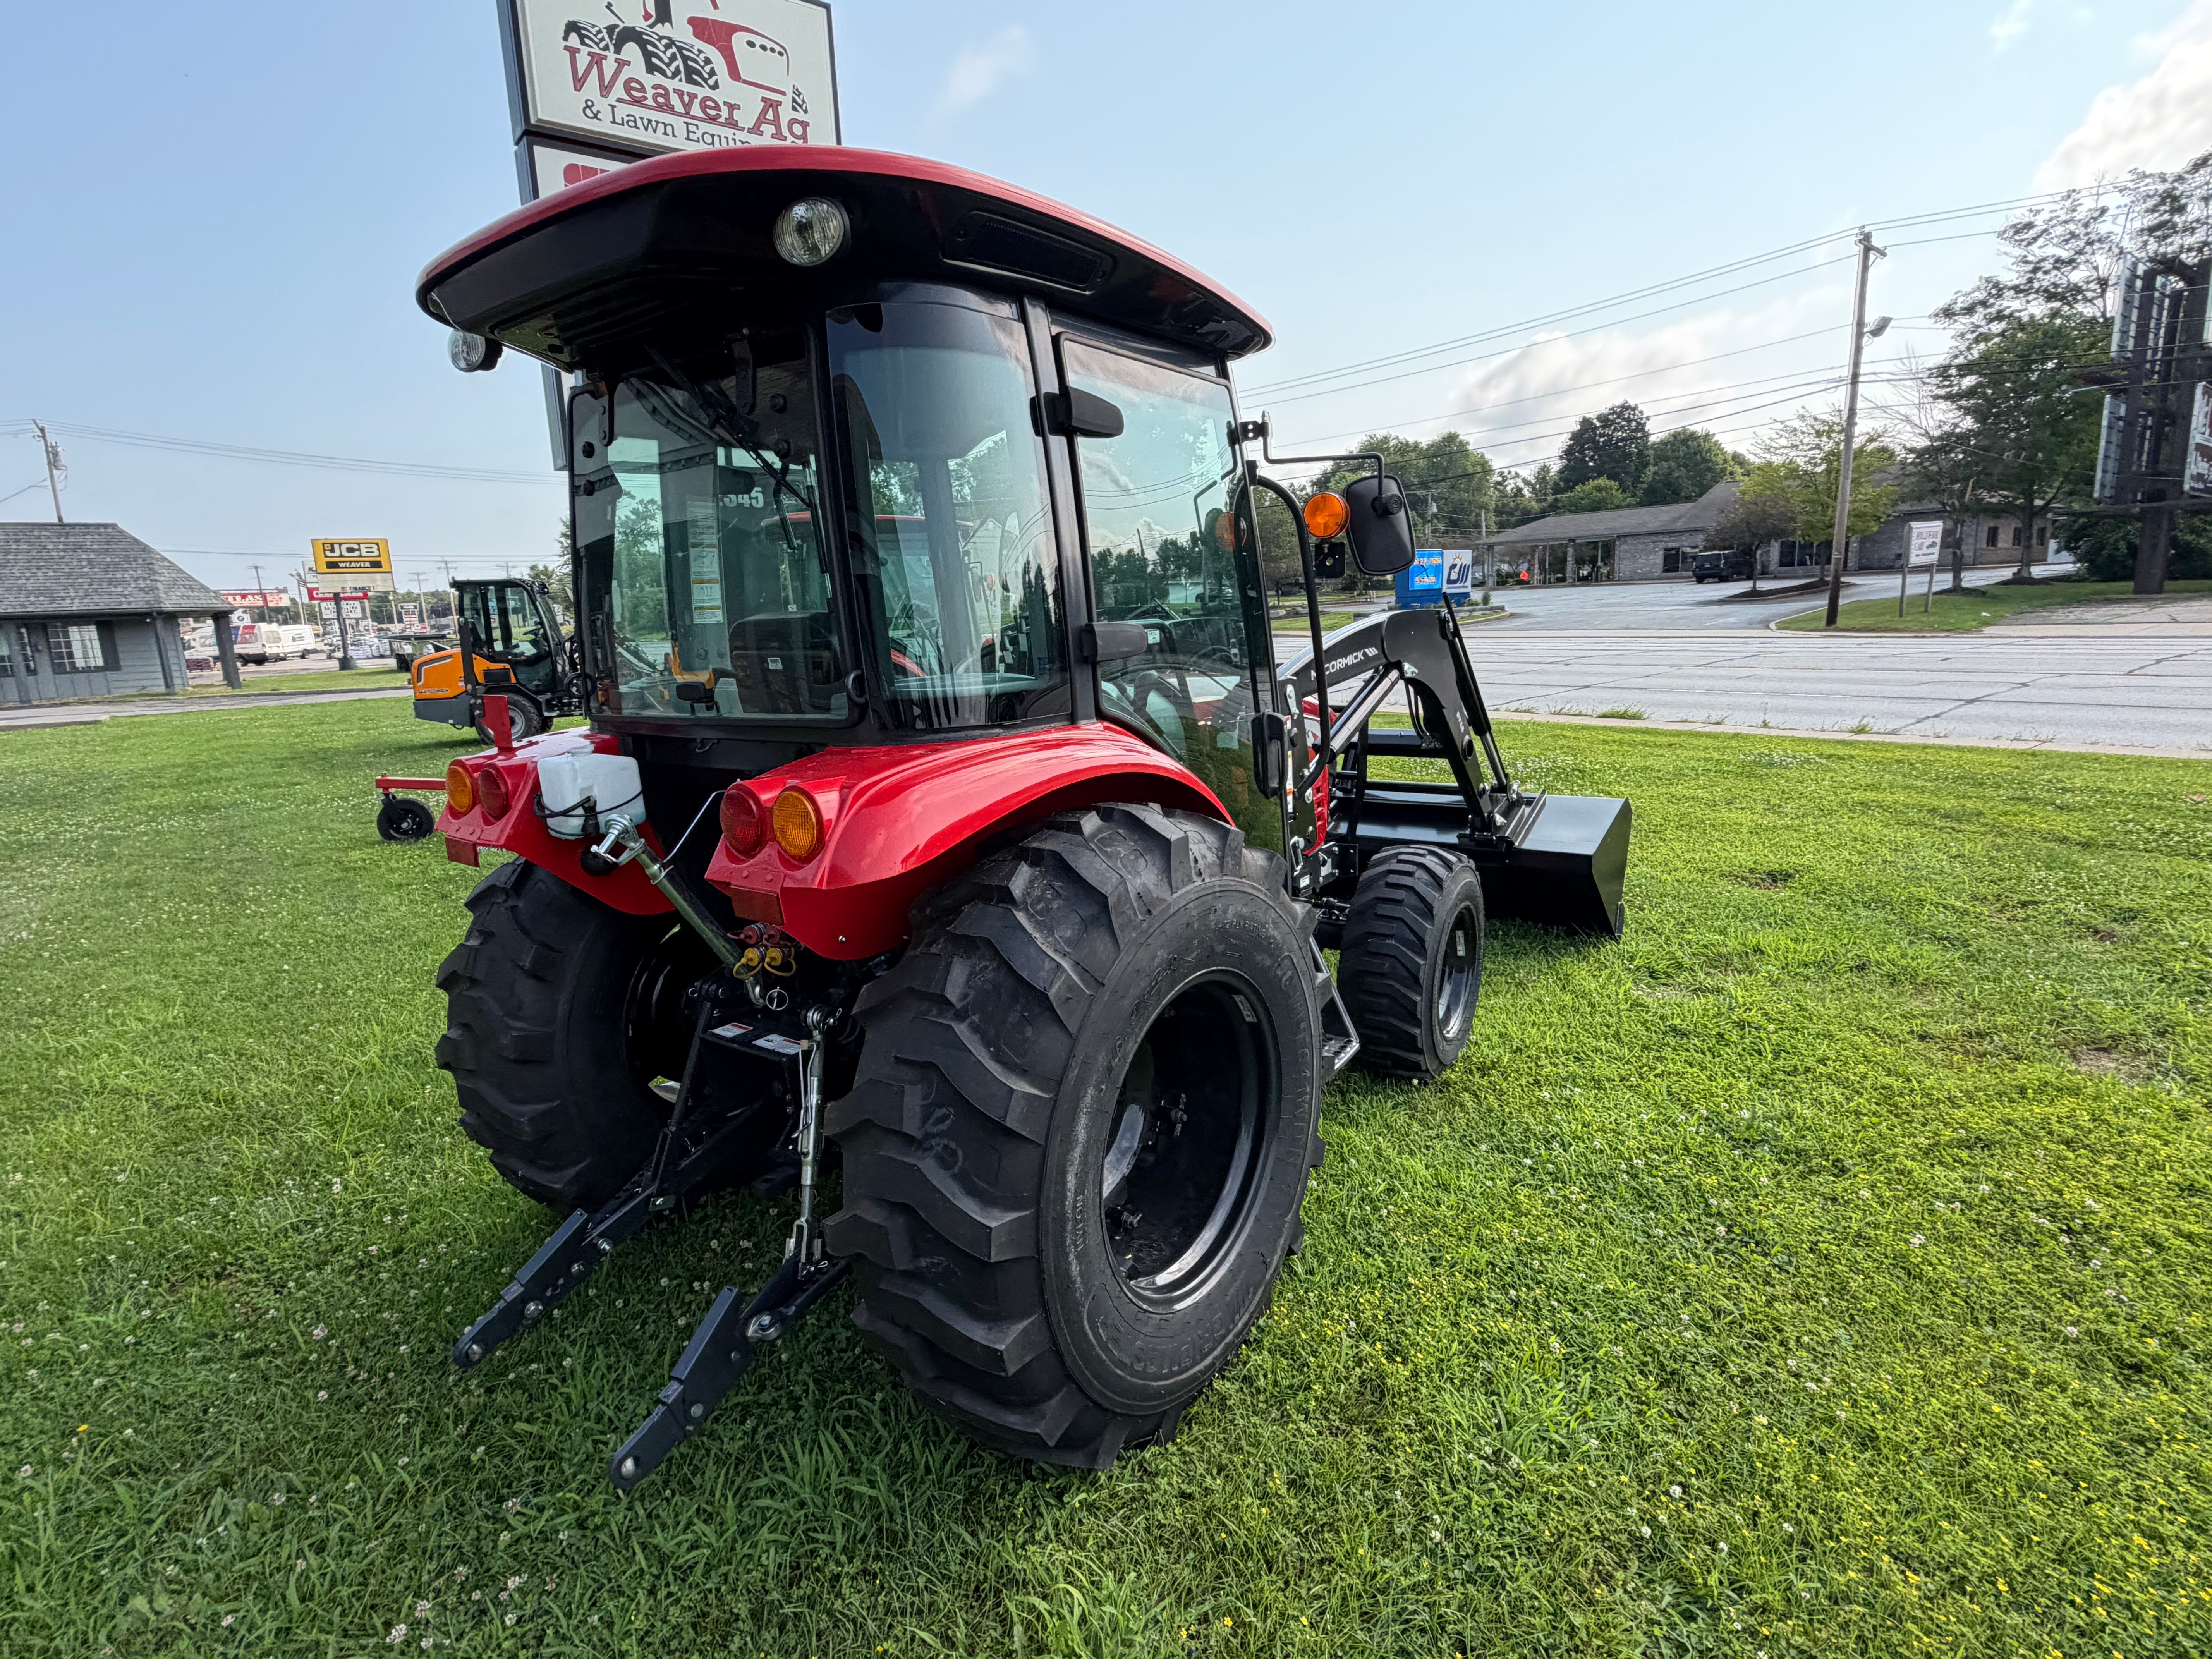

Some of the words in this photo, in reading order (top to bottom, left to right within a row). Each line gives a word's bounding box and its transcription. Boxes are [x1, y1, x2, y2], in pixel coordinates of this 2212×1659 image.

[563, 45, 741, 126] Weaver
[747, 96, 810, 144] Ag
[582, 98, 603, 121] &
[608, 103, 677, 138] Lawn
[324, 543, 380, 557] JCB
[1310, 649, 1364, 681] MCORMICK
